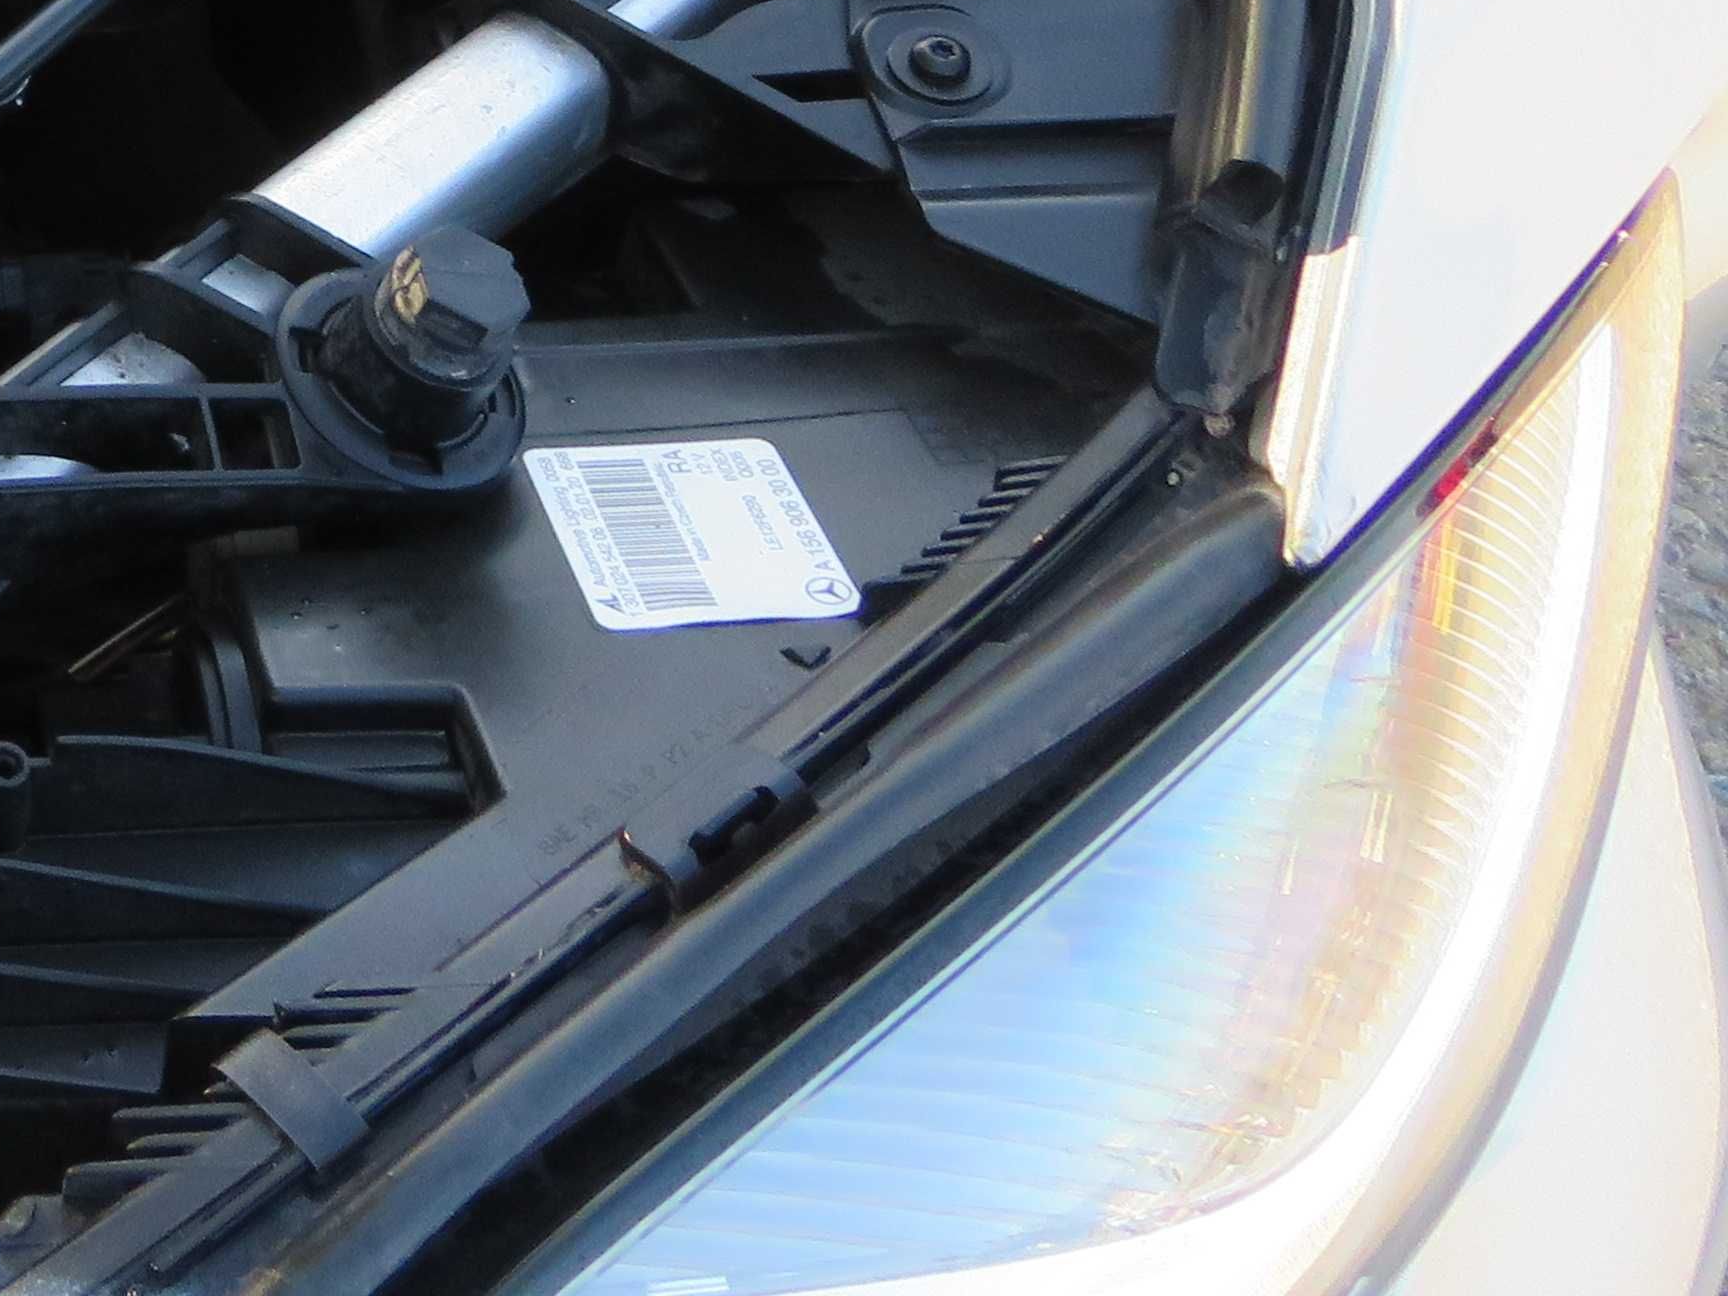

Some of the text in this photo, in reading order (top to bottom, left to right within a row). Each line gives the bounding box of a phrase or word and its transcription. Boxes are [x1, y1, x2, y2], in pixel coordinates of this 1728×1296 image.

[659, 449, 692, 473] RA
[550, 486, 582, 525] Lighting
[754, 458, 835, 571] A 156 906 30 00
